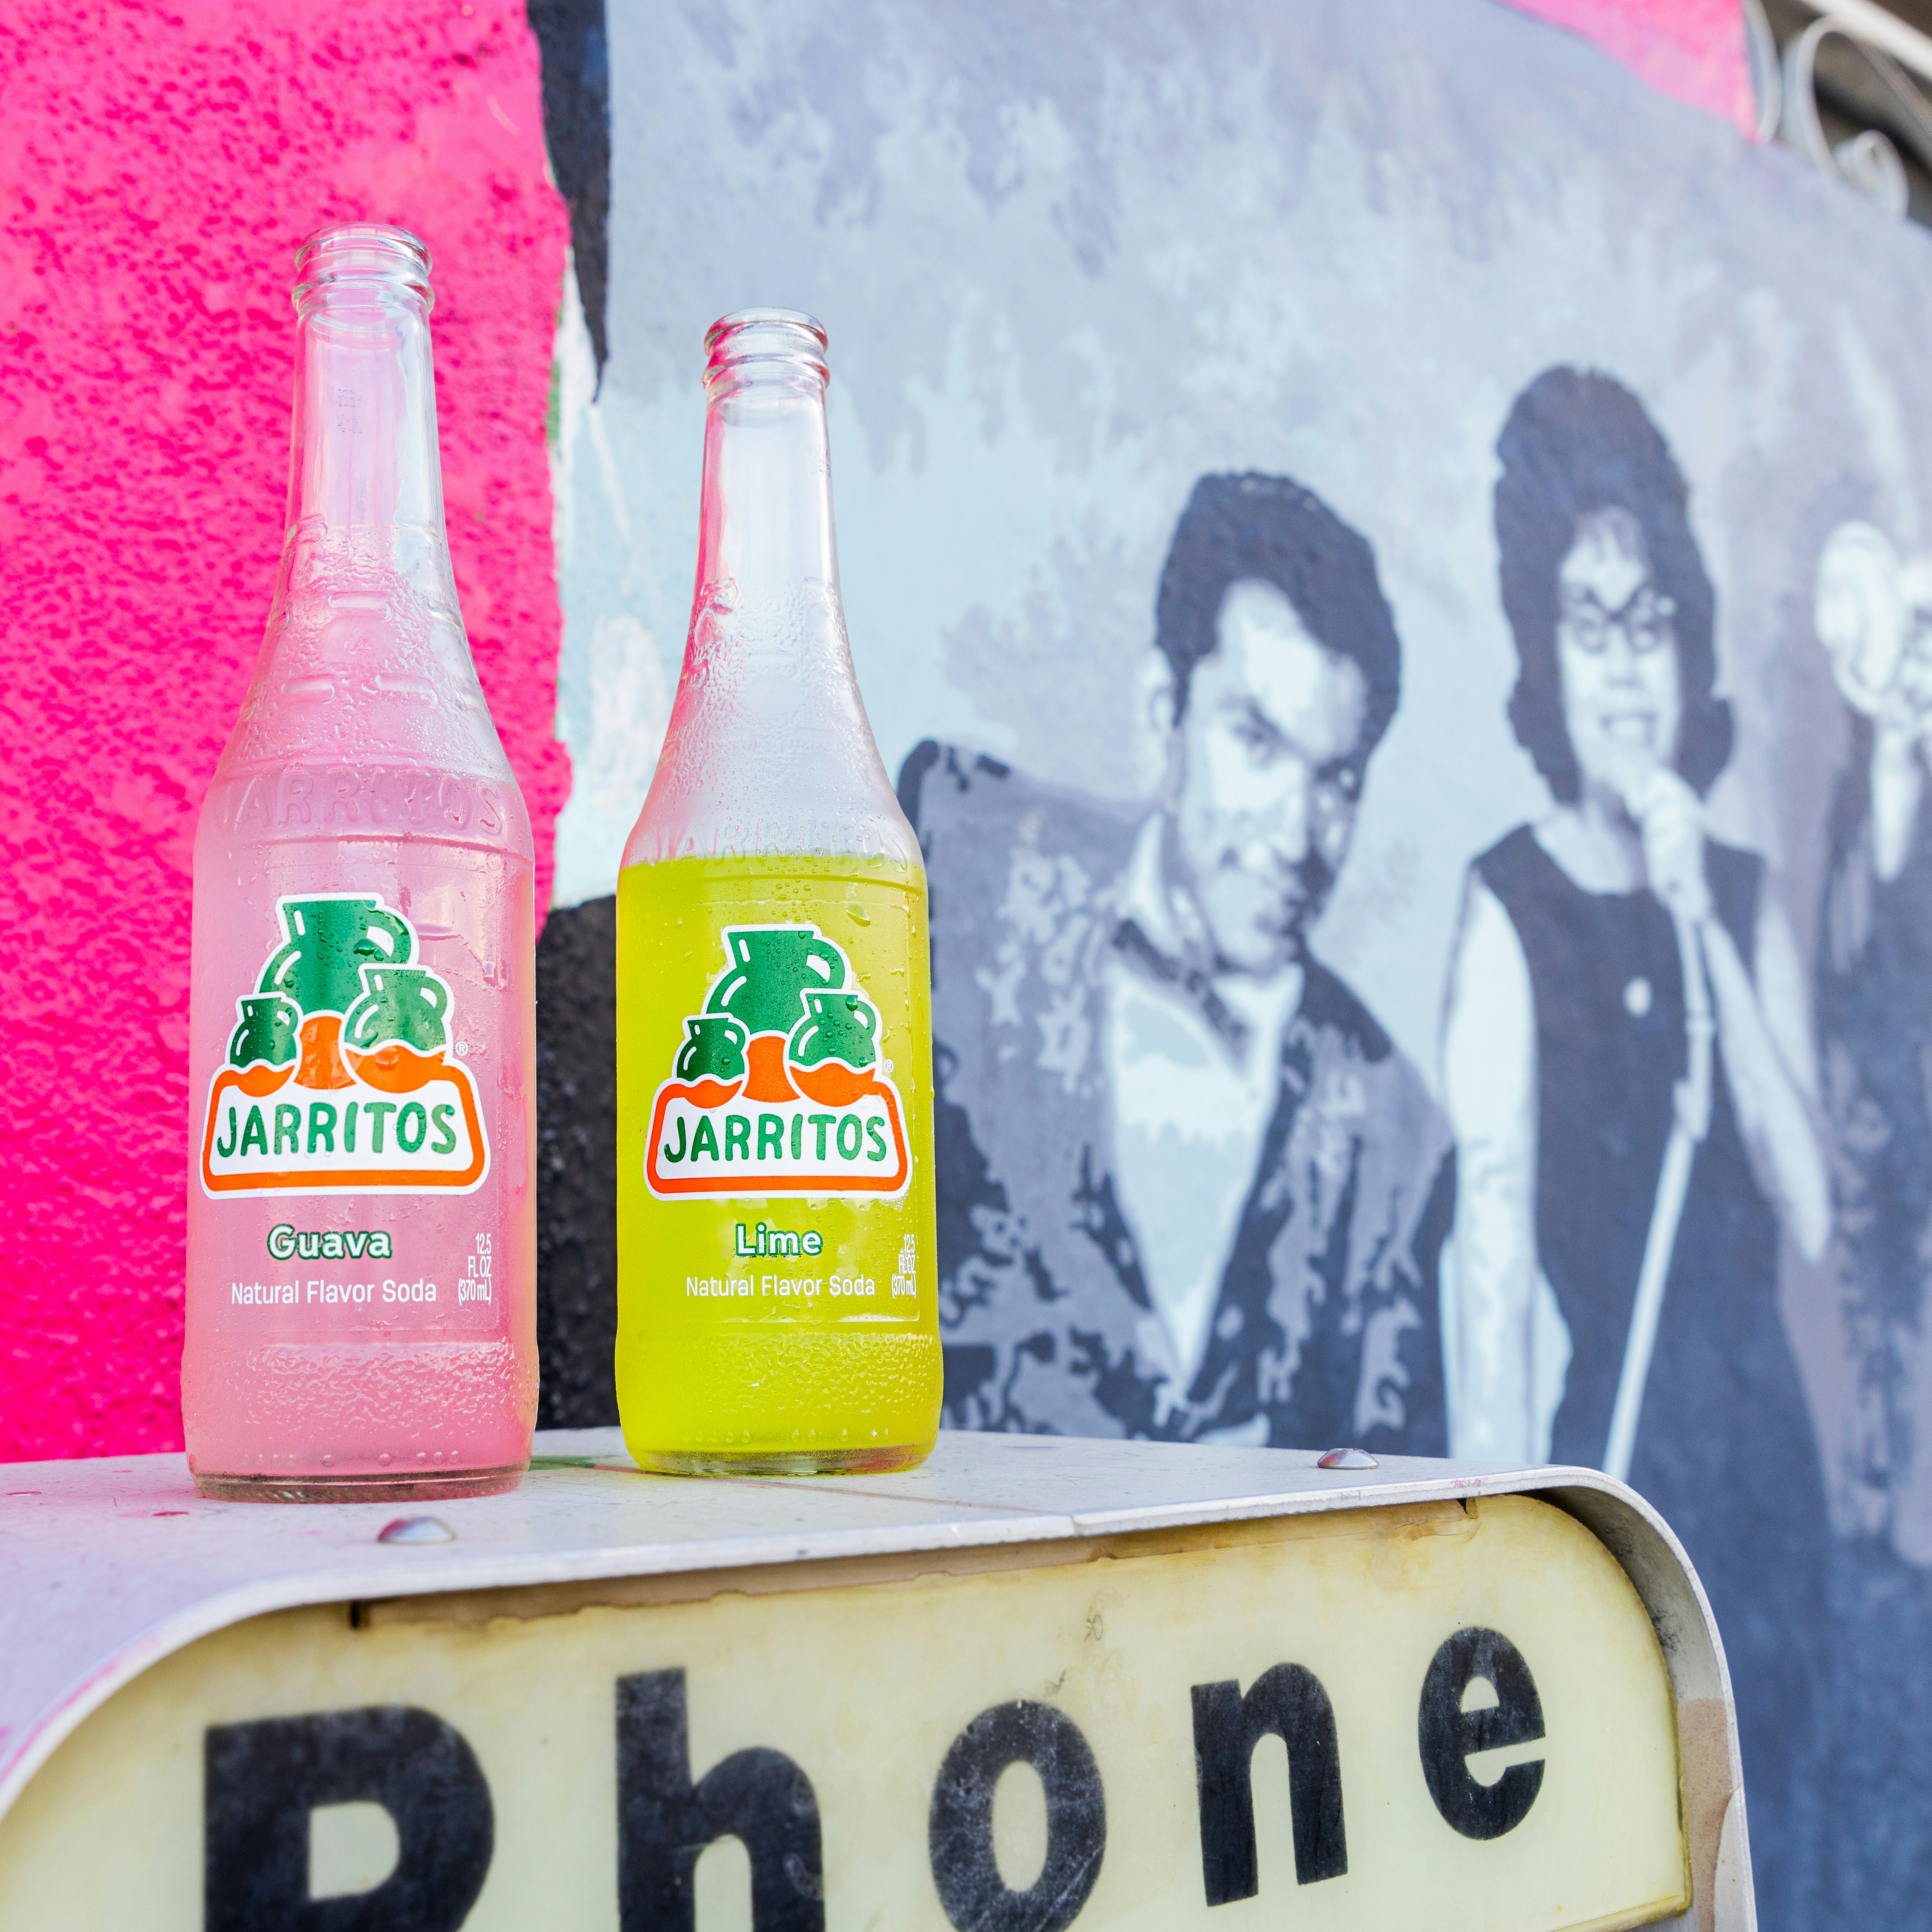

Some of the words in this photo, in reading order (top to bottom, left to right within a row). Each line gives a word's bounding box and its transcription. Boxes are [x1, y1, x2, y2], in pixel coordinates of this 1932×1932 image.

[217, 1101, 457, 1158] JARRITOS
[663, 1113, 887, 1163] JARRITOS
[268, 1224, 392, 1260] Guava
[475, 1233, 492, 1254] 12.5
[736, 1222, 823, 1256] Lime
[903, 1233, 915, 1253] 12.5
[468, 1256, 478, 1278] FL
[479, 1255, 492, 1278] OZ
[232, 1280, 299, 1305] Natural
[307, 1279, 375, 1303] Flavor
[382, 1278, 436, 1302] Soda
[458, 1278, 476, 1305] (370
[477, 1278, 492, 1305] mL)
[686, 1274, 754, 1297] Natural
[762, 1274, 823, 1296] Flavor
[829, 1274, 875, 1297] Soda
[891, 1274, 905, 1299] (370
[906, 1274, 917, 1299] mL)
[203, 1625, 1547, 1932] Phone
